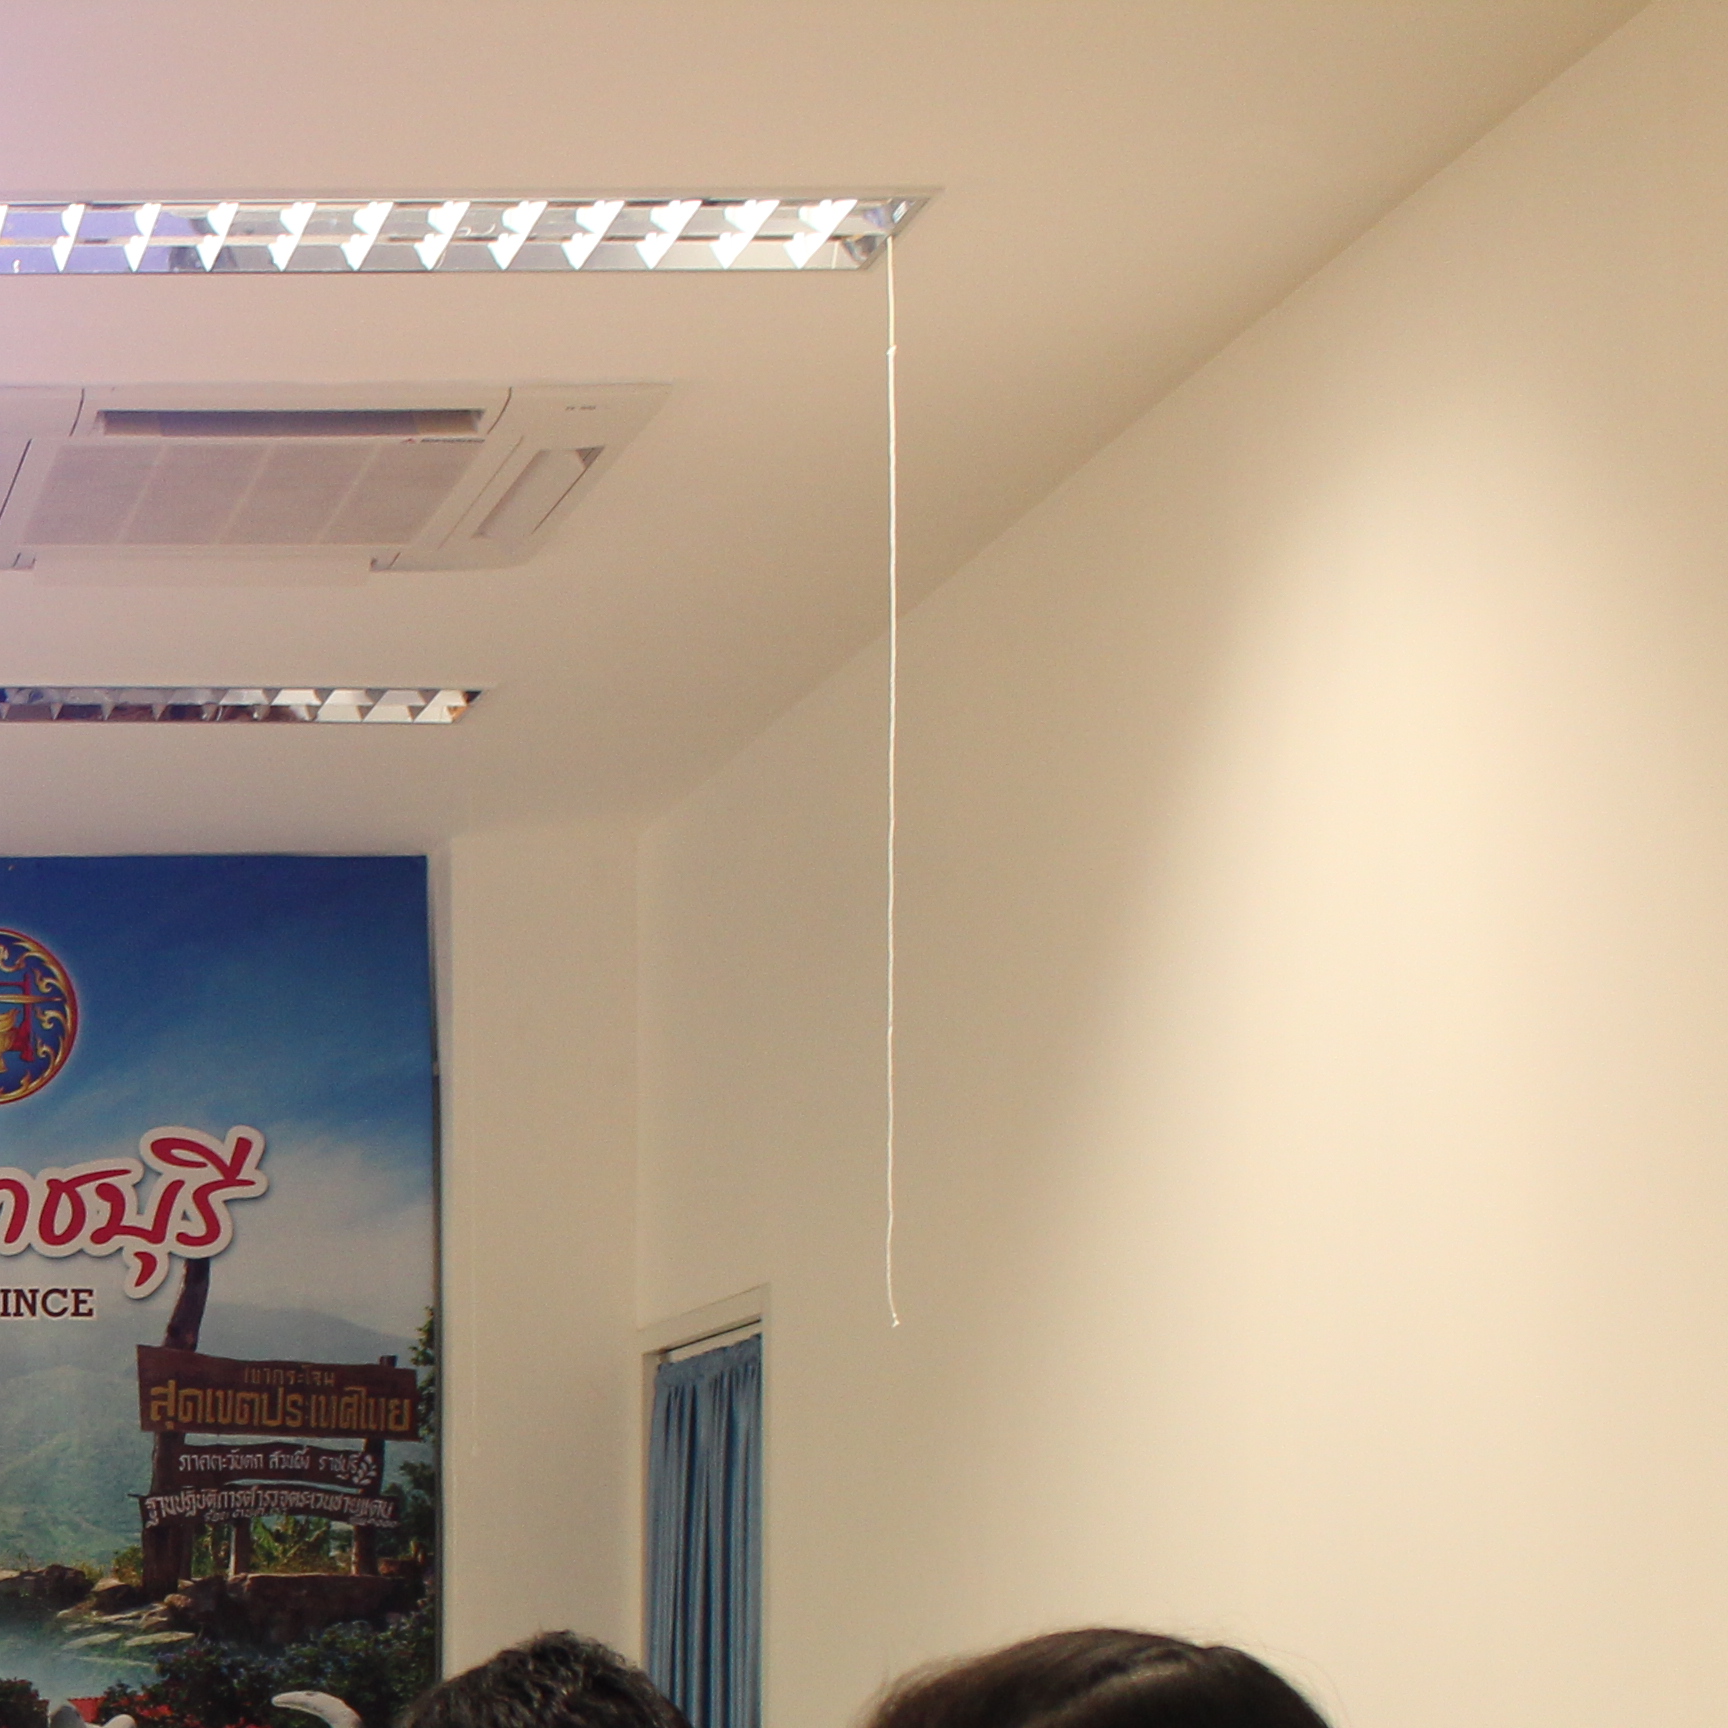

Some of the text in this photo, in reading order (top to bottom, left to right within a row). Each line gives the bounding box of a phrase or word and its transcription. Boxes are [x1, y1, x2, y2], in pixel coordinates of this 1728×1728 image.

[149, 1379, 411, 1432] สุดเขตประเทศไทย
